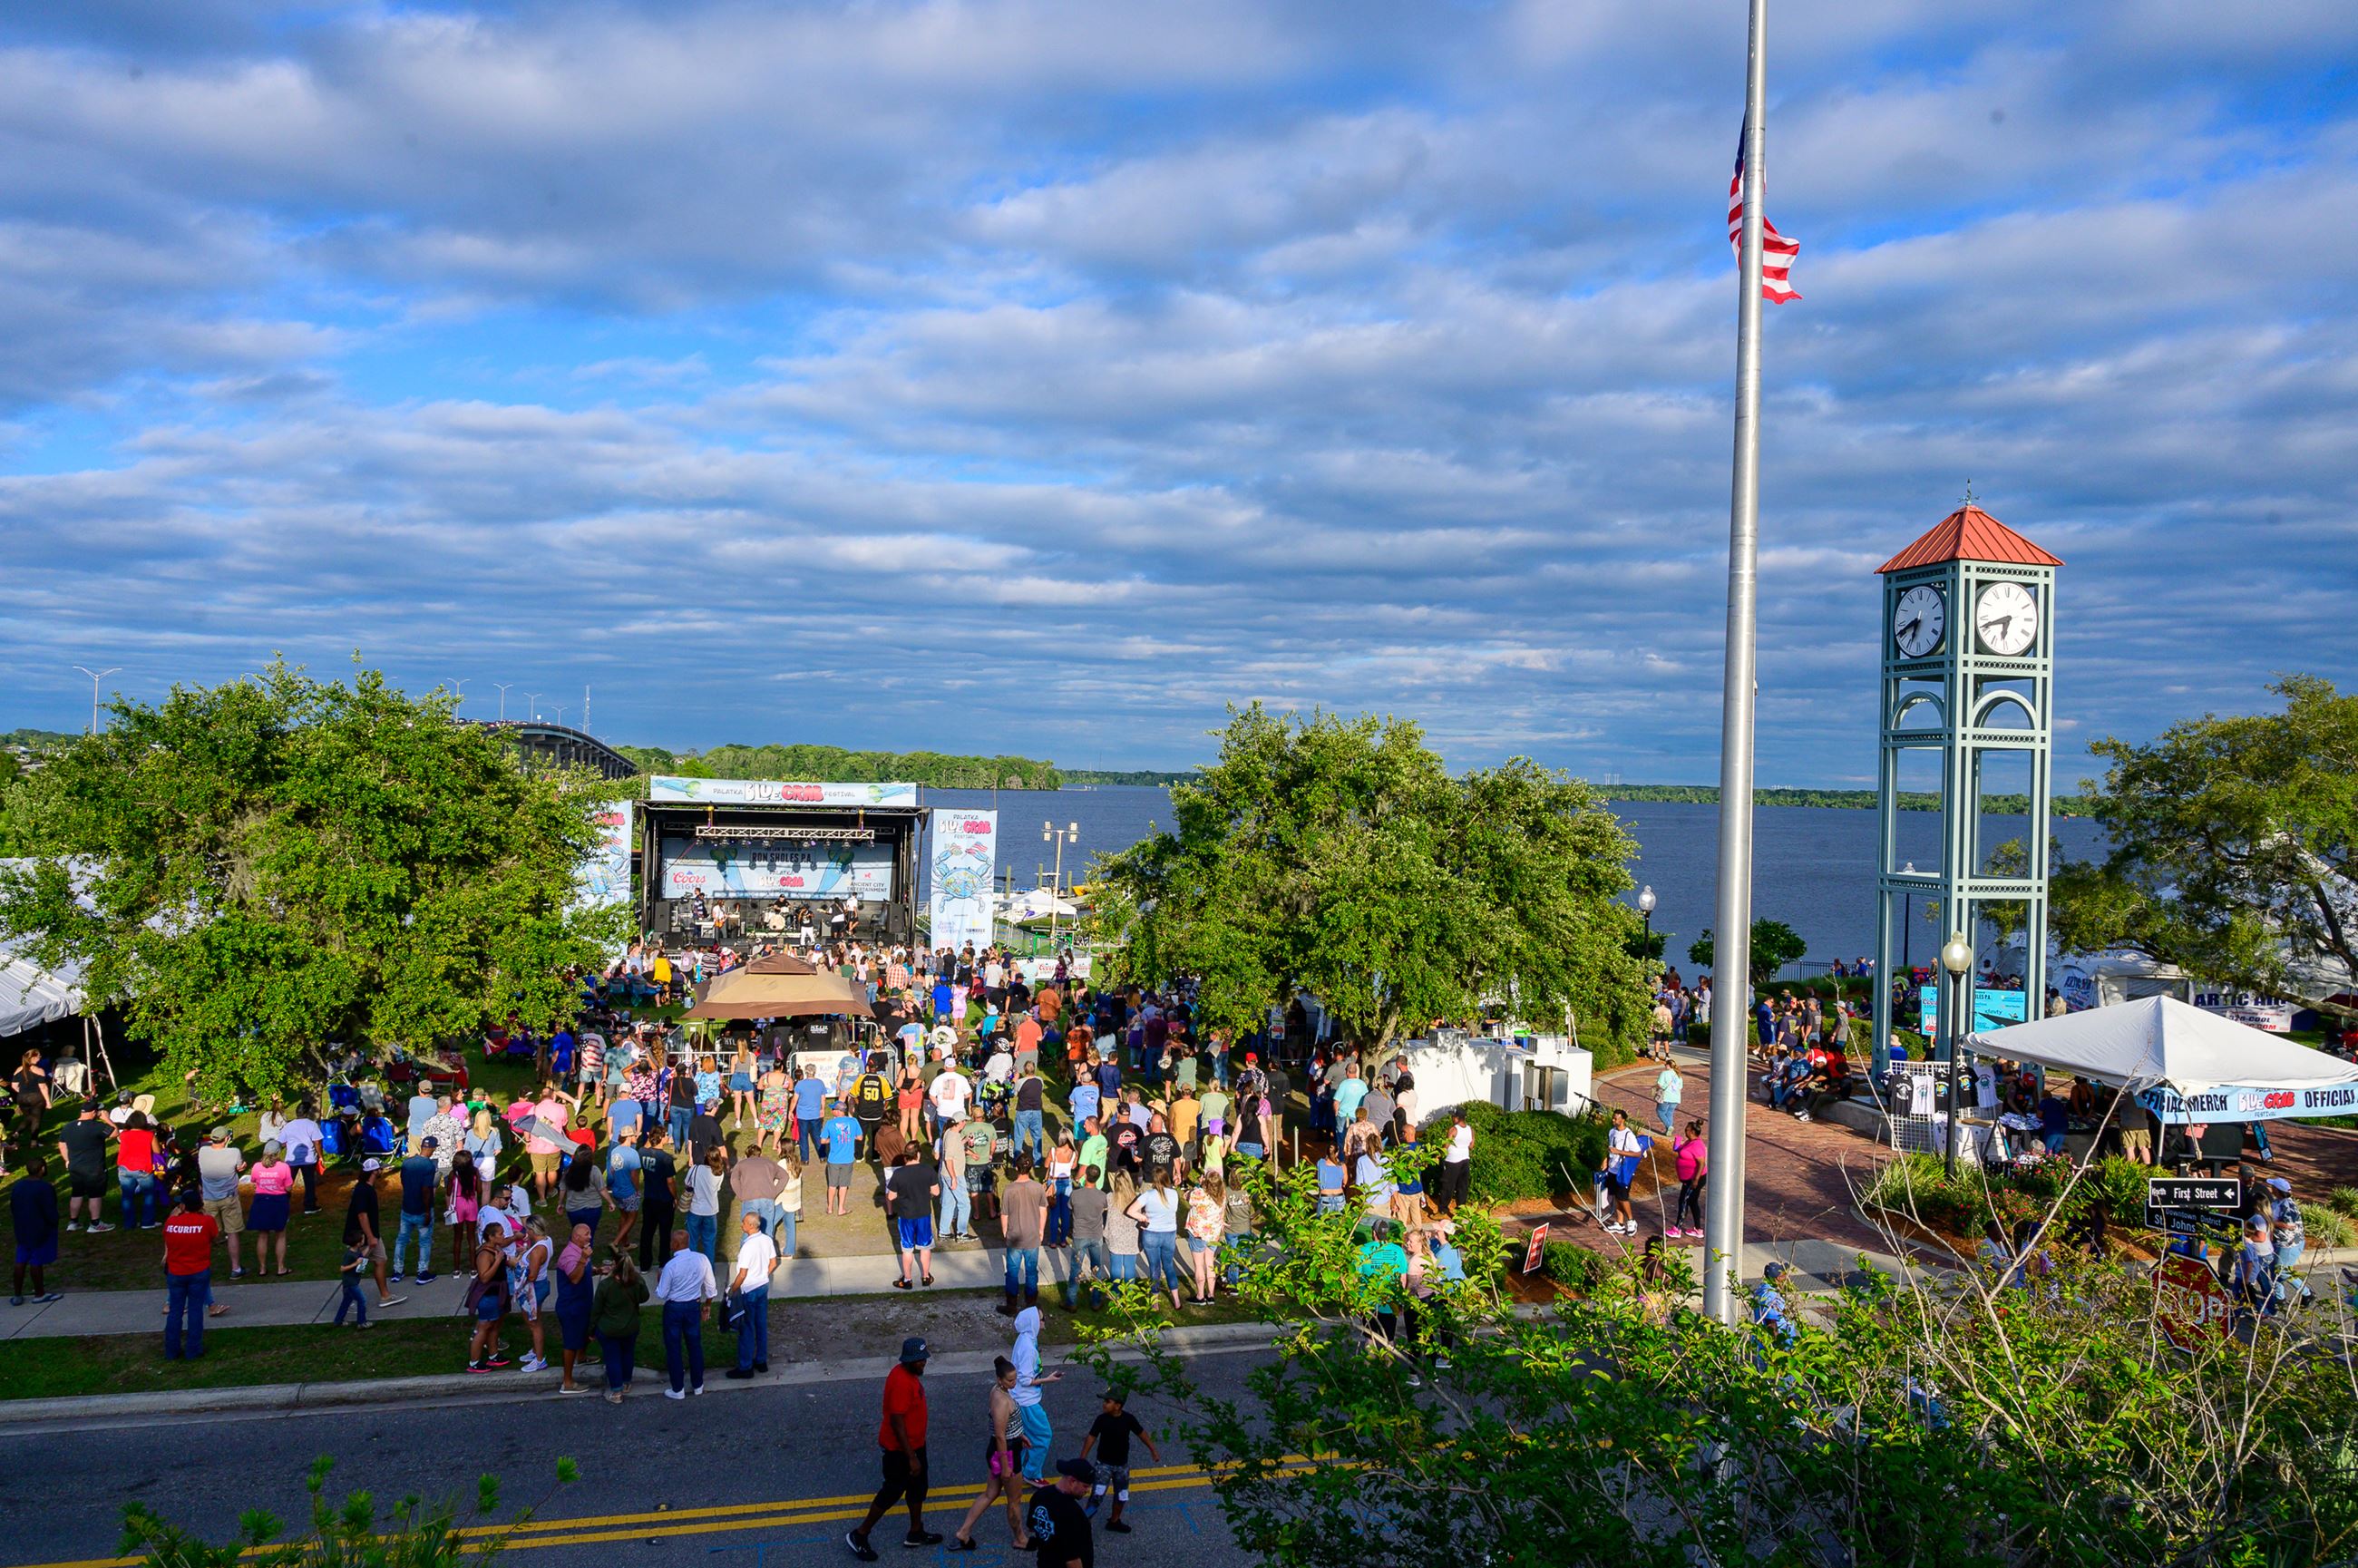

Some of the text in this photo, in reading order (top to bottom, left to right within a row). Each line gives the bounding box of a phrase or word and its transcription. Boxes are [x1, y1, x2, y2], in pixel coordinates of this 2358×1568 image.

[744, 782, 782, 802] BLUE
[781, 784, 824, 802] CRAB
[939, 819, 991, 834] BLUE CRAB
[752, 852, 768, 862] RON
[769, 852, 799, 862] SHOLES
[673, 872, 706, 883] Coors
[863, 1086, 880, 1101] 50
[2187, 1094, 2228, 1113] MERCH
[2238, 1091, 2295, 1113] BLUE CRAB
[1152, 1154, 1171, 1164] FIGHT
[2173, 1187, 2191, 1200] First
[2195, 1187, 2218, 1199] Street
[2165, 1208, 2222, 1227] Downtown District
[2171, 1218, 2196, 1232] Johns
[2158, 1280, 2225, 1325] STOP
